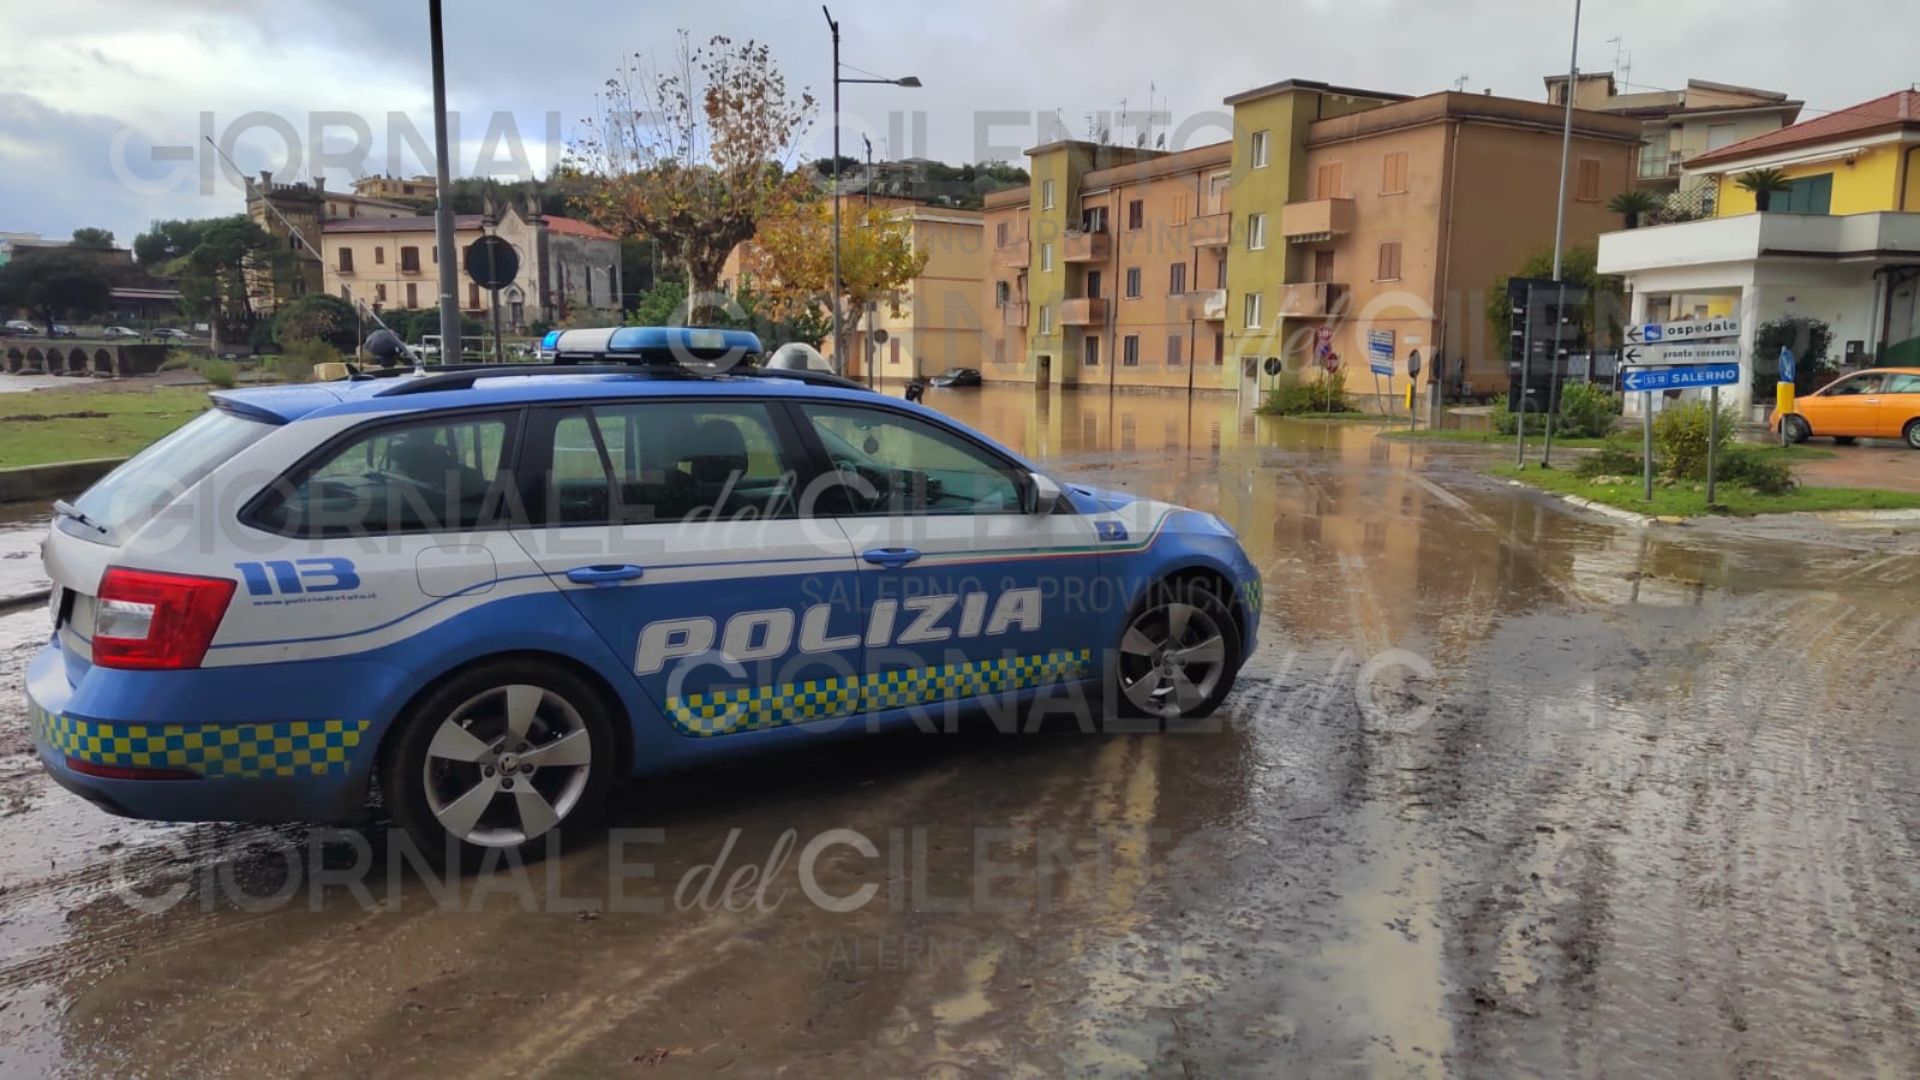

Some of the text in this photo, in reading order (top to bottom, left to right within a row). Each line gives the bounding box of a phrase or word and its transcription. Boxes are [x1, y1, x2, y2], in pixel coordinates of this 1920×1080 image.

[1668, 321, 1737, 336] ospedale
[1672, 369, 1736, 384] SALERNO
[234, 557, 360, 596] 113
[634, 586, 1042, 676] POLIZIA
